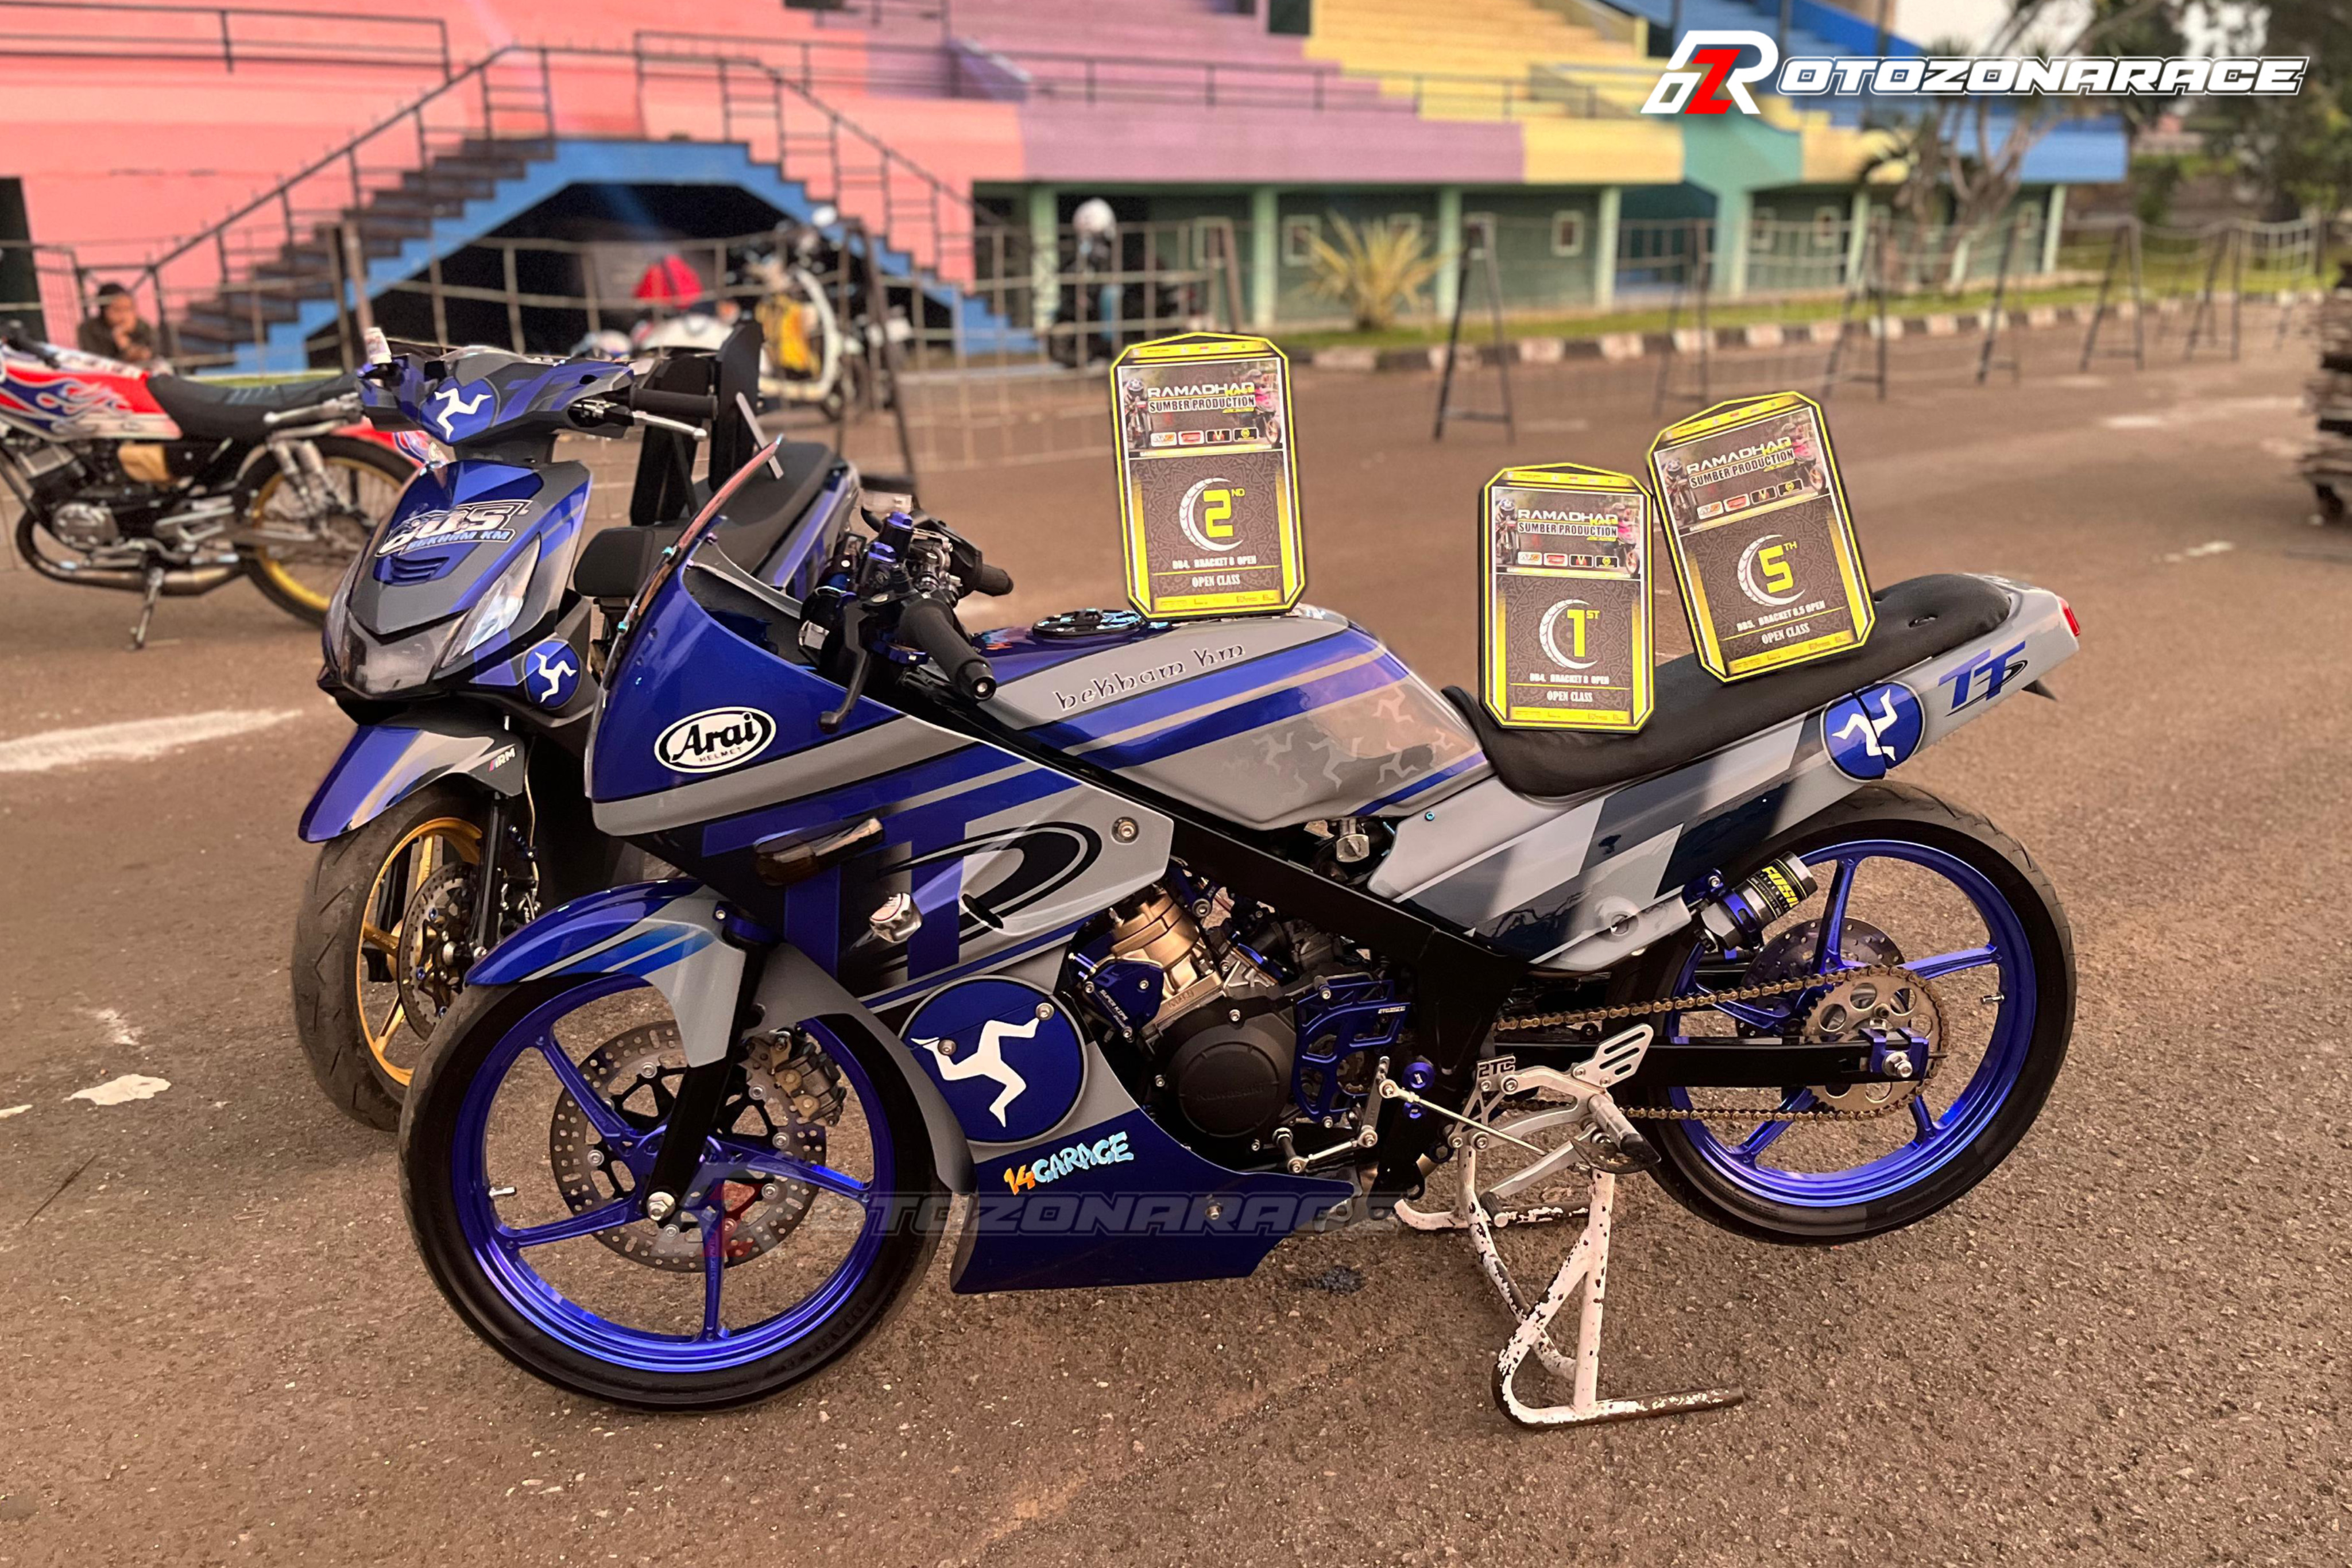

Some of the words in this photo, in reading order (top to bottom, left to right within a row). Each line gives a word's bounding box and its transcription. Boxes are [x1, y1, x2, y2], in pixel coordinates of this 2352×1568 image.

[1148, 398, 1190, 413] SUMBER
[1192, 394, 1256, 411] PRODUCTION
[1688, 466, 1731, 489] SUMBER
[1732, 448, 1795, 476] PRODUCTION
[1518, 521, 1558, 535] SUMBER
[1558, 522, 1619, 537] PRODUCTION
[1193, 556, 1229, 568] BRACKET
[1237, 555, 1258, 566] OPEN
[1192, 576, 1216, 588] OPEN
[1216, 574, 1241, 586] CLASS
[1758, 611, 1793, 626] BRACKET
[1805, 600, 1826, 614] OPEN
[1761, 629, 1786, 645] OPEN
[1786, 623, 1811, 638] CLASS
[1550, 674, 1583, 684] BRACKET
[1591, 676, 1610, 685] OPEN
[1546, 690, 1570, 702] OPEN
[1570, 691, 1593, 703] CLASS
[668, 713, 760, 763] Arai
[698, 746, 744, 764] HELMET
